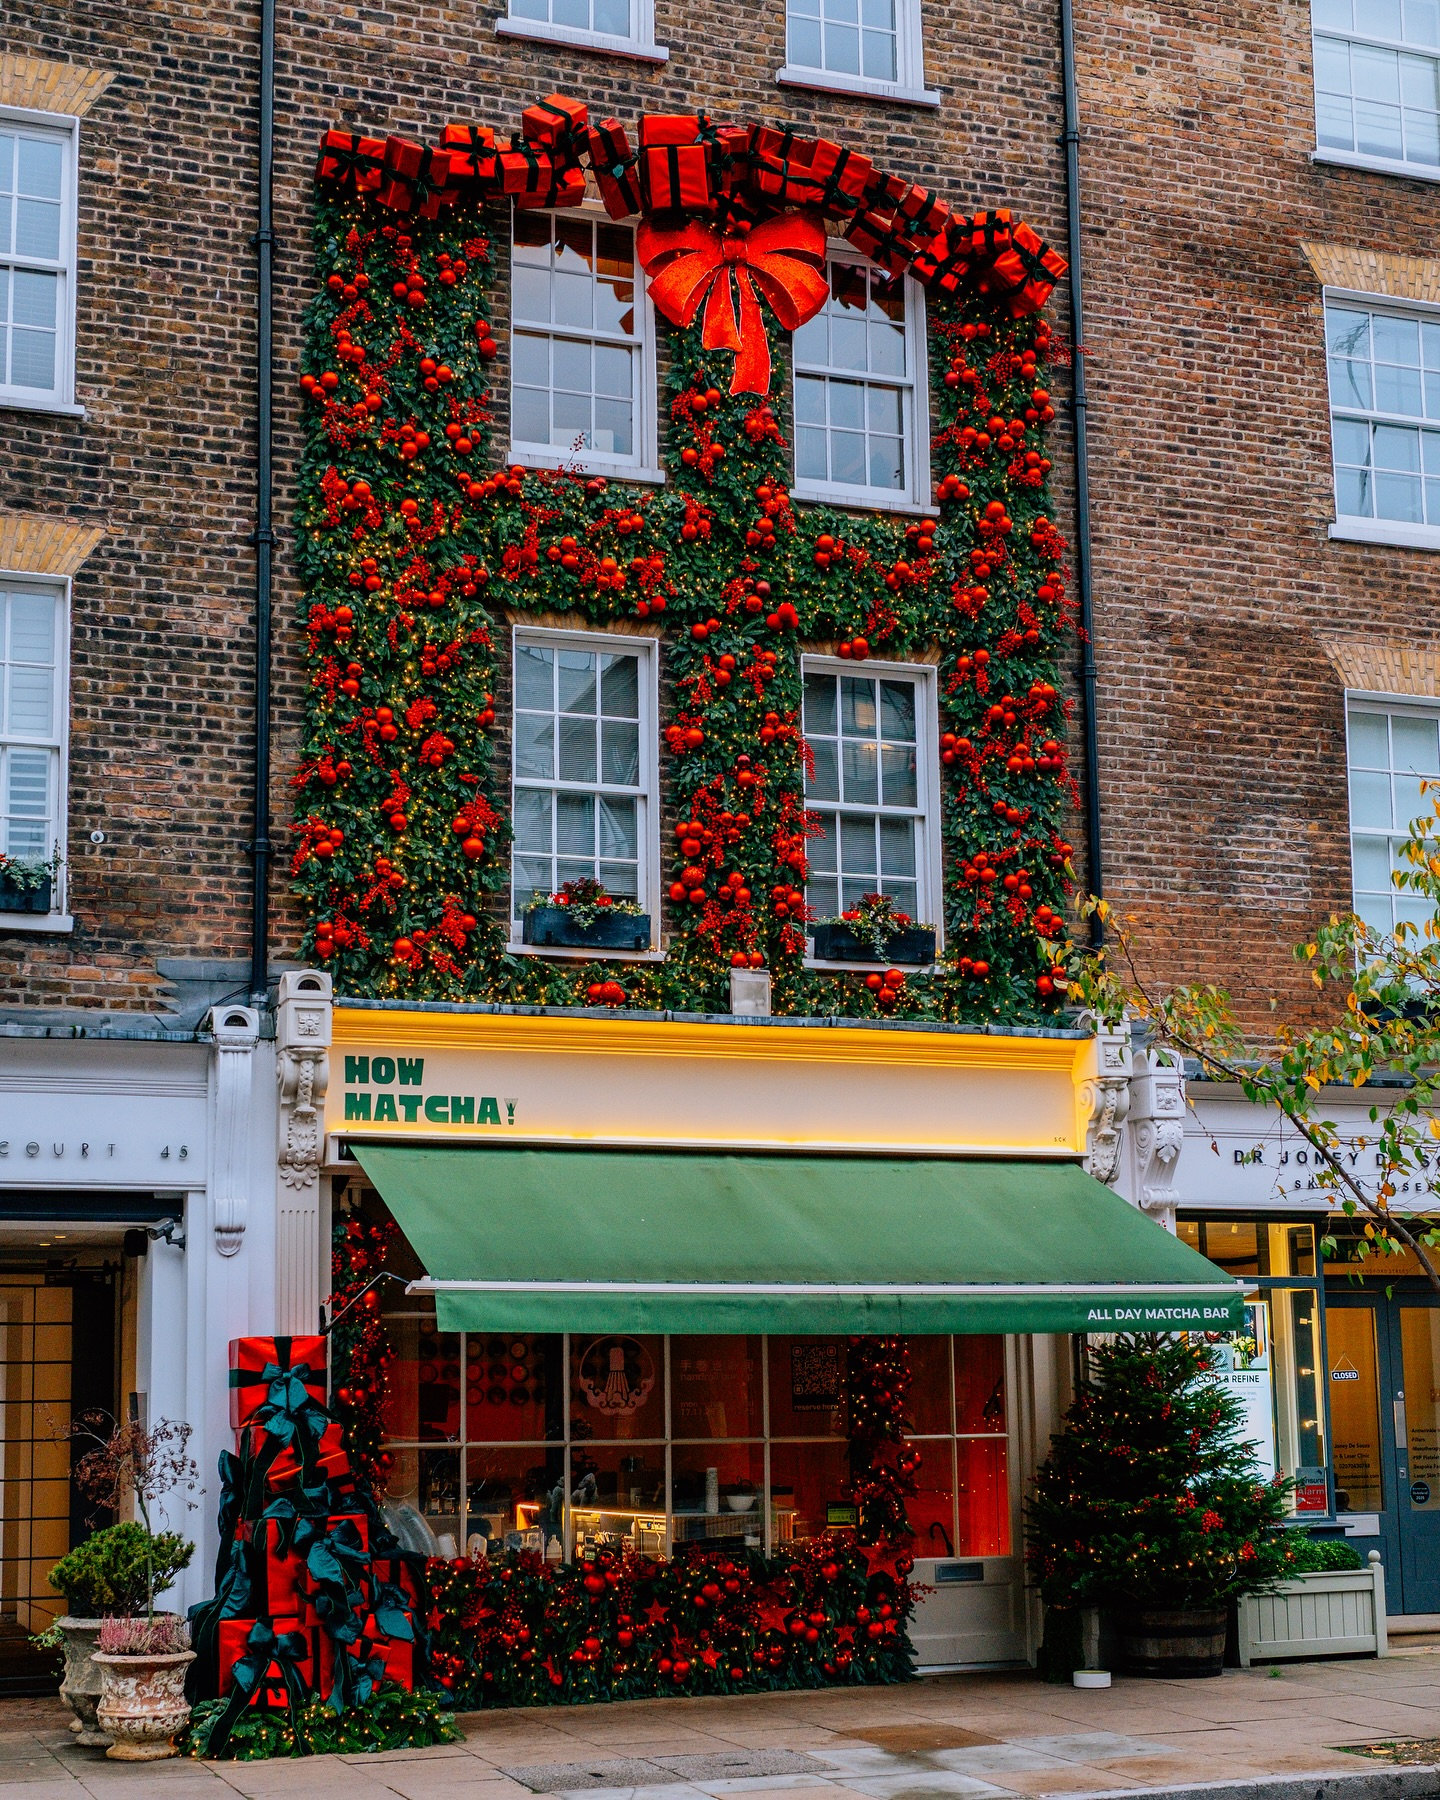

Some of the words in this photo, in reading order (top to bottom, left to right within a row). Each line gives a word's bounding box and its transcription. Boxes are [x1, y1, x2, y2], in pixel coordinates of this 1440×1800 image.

[345, 1056, 424, 1086] HOW
[0, 1141, 116, 1157] COURT
[160, 1144, 189, 1158] 45
[1234, 1149, 1263, 1164] DR
[1280, 1150, 1359, 1166] JONEY
[1088, 1309, 1112, 1320] ALL
[1115, 1309, 1142, 1320] DAY
[1145, 1308, 1200, 1319] MATCHA
[1203, 1307, 1229, 1319] BAR
[1231, 1374, 1260, 1383] REFINE
[1297, 1488, 1325, 1496] Alarm
